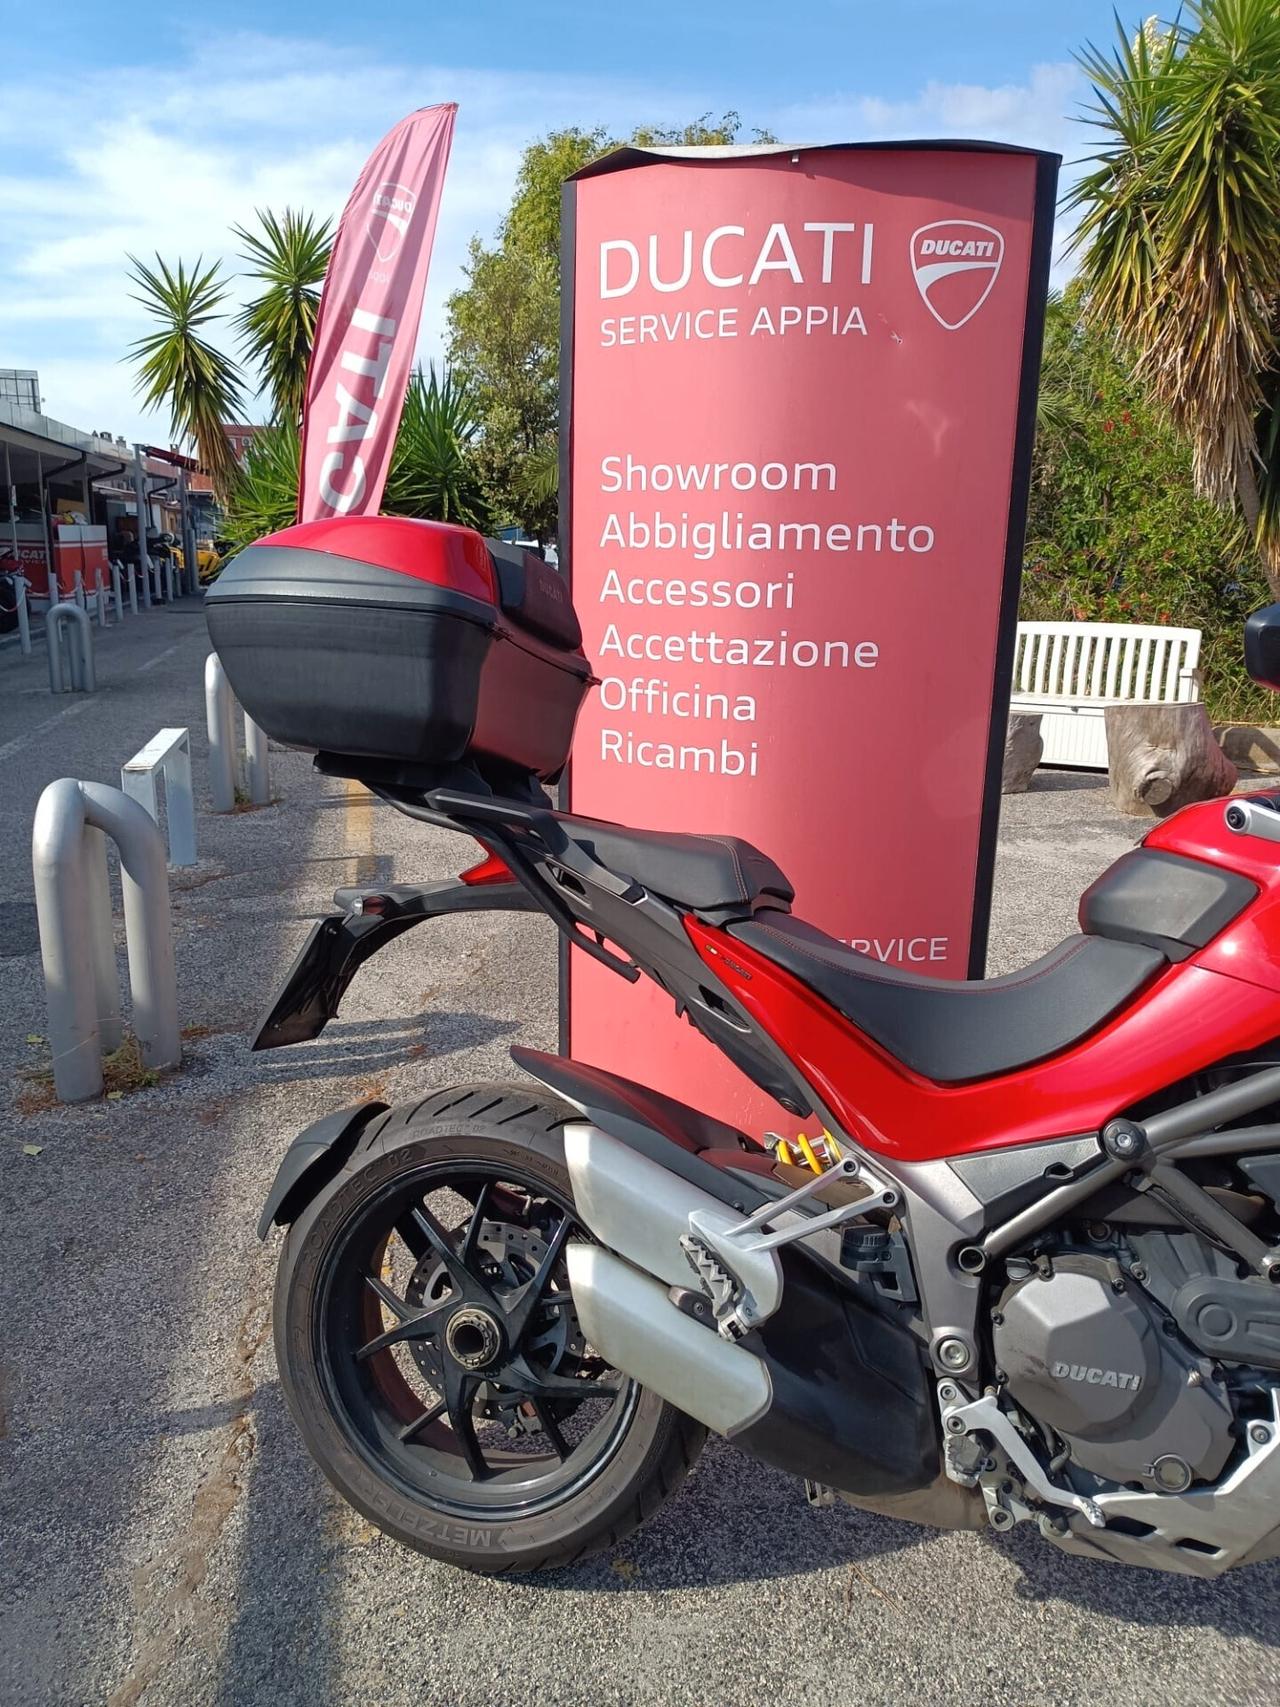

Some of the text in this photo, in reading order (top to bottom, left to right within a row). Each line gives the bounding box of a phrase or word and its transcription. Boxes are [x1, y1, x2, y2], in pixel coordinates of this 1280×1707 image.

[600, 222, 874, 299] DUCATI
[919, 239, 995, 258] DUCATI
[600, 305, 868, 347] SERVICE APPIA
[601, 453, 837, 492] Showroom
[599, 511, 935, 560] Abbigliamento
[599, 569, 794, 609] Accessori
[598, 623, 879, 668] Accettazione
[600, 677, 756, 721] Officina
[601, 728, 758, 777] Ricambi
[838, 937, 948, 962] RVICE
[1050, 1361, 1141, 1392] DUCATI
